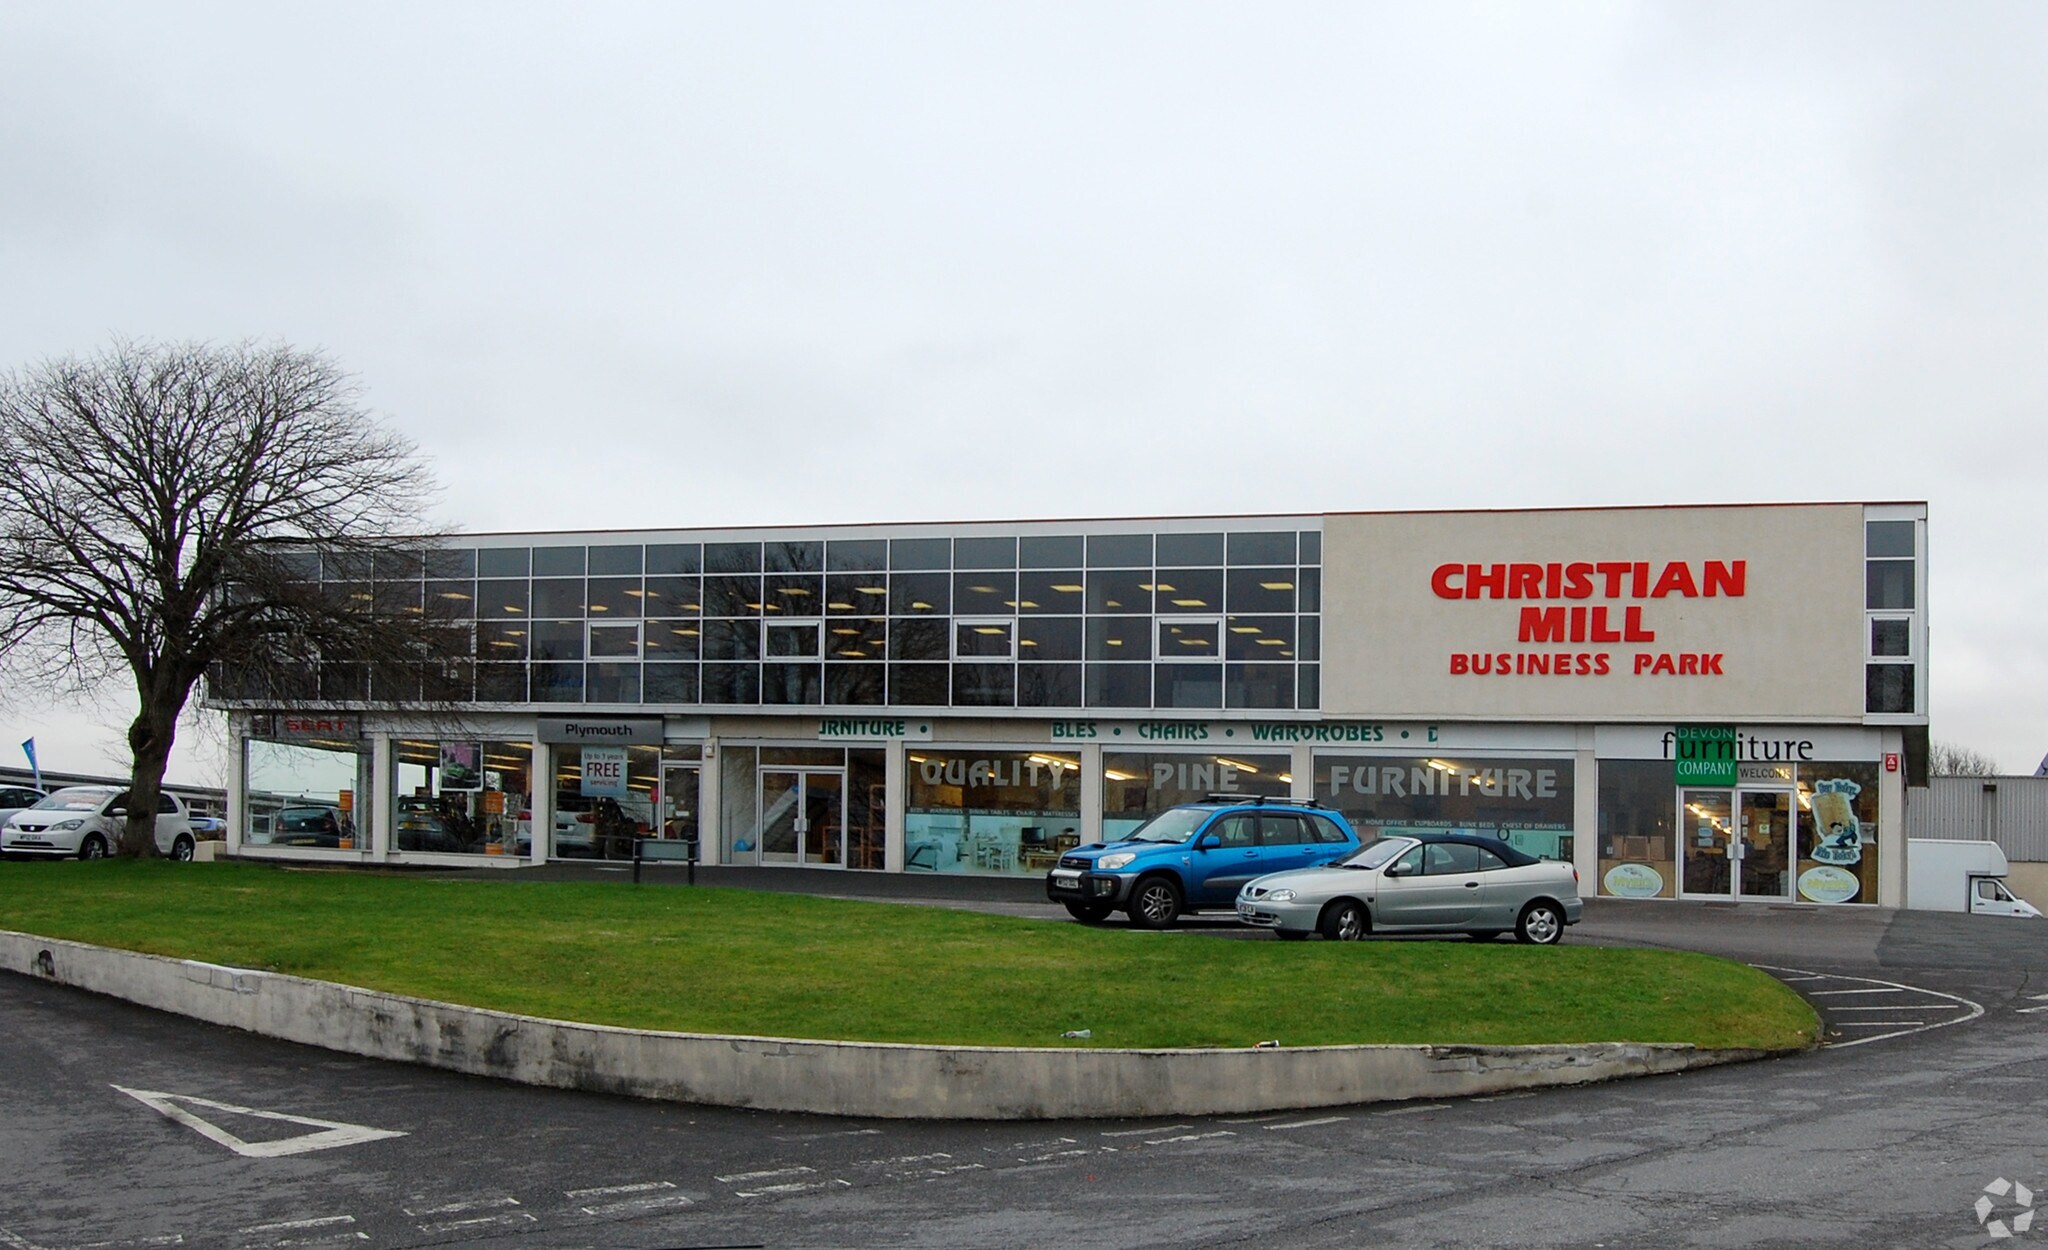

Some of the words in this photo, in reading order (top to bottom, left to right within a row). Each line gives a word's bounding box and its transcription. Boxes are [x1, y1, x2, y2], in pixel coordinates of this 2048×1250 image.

[1430, 560, 1747, 600] CHRISTIAN
[1517, 606, 1655, 643] MILL
[1450, 653, 1610, 676] BUSINESS
[1633, 653, 1724, 676] PARK
[564, 723, 633, 738] Plymouth
[1052, 721, 1098, 738] BLES
[1138, 722, 1209, 741] CHAIRS
[1252, 724, 1384, 743] WARDROBES
[1678, 727, 1734, 739] DEVON
[1661, 731, 1814, 760] furniture
[586, 761, 621, 778] FREE
[919, 758, 1066, 791] QUALITY
[1153, 762, 1240, 792] PINE
[1677, 760, 1734, 775] COMPANY
[1330, 765, 1557, 801] FURNITURE
